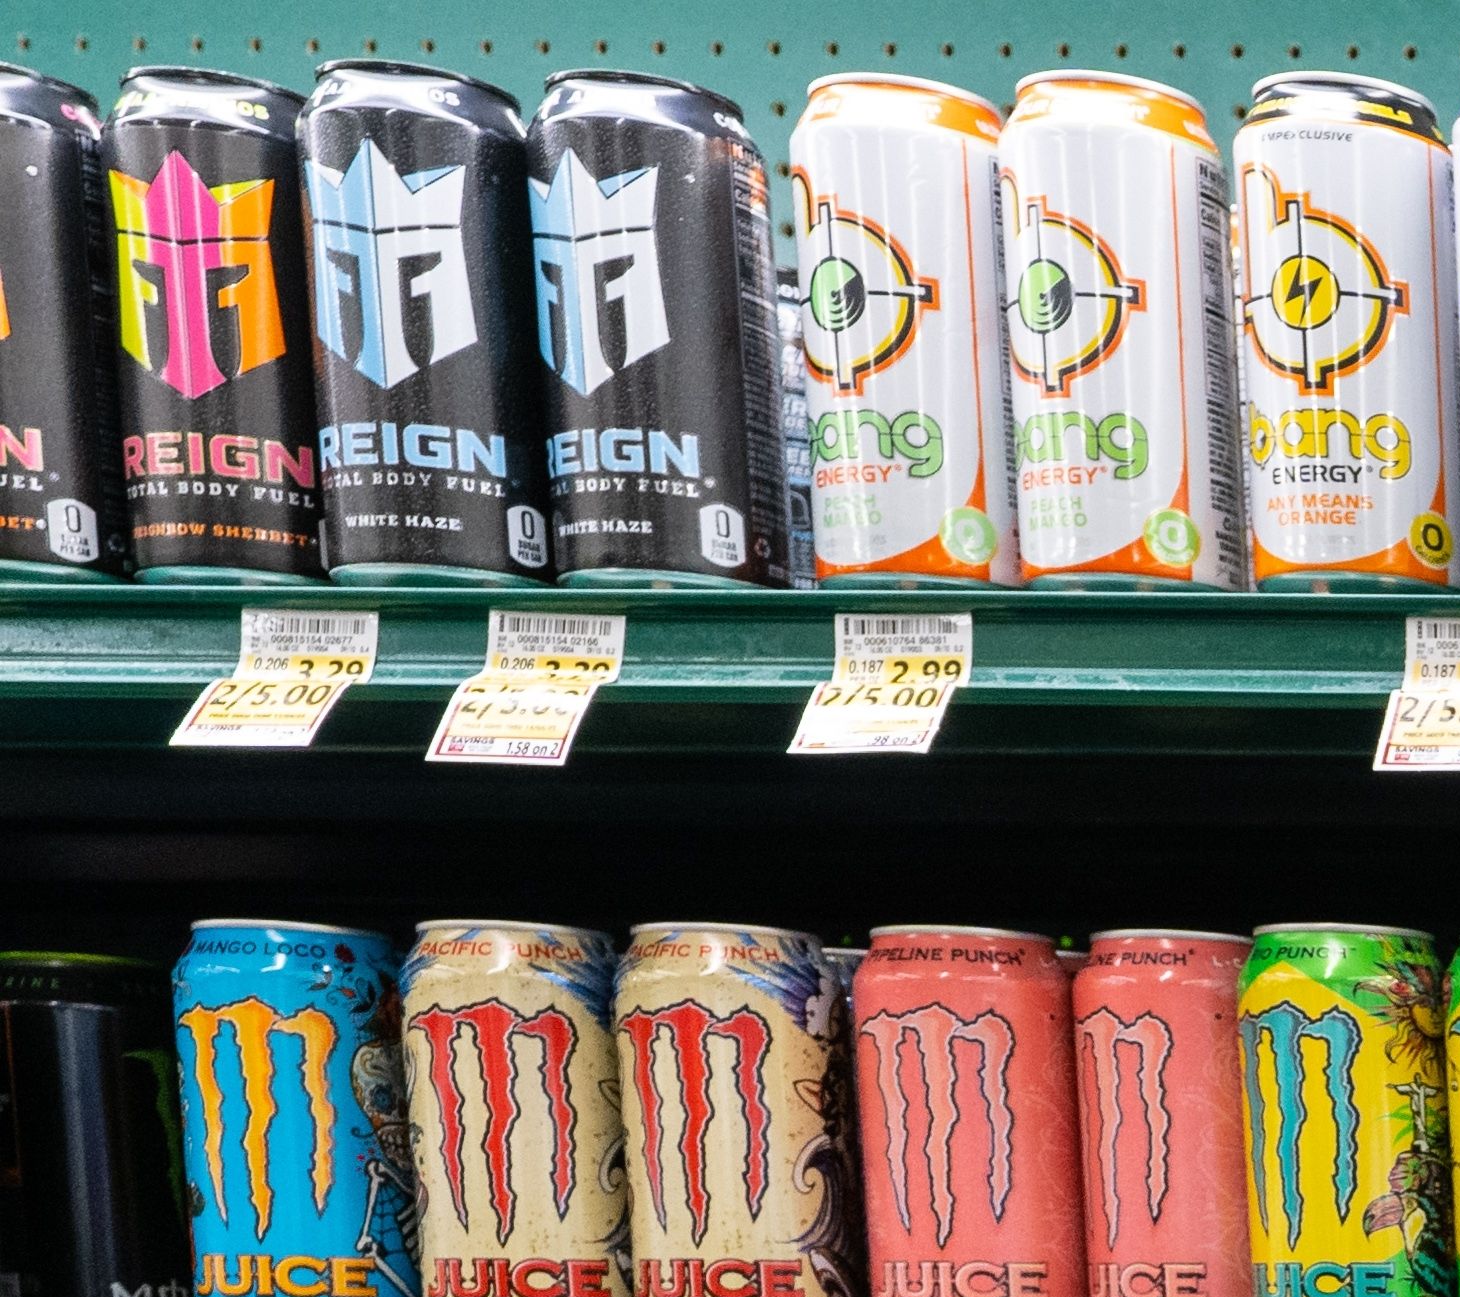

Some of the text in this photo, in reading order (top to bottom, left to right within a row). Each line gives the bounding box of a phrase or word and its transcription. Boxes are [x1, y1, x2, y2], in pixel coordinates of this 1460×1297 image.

[123, 431, 315, 483] REIGN
[345, 513, 462, 532] WHITE HAZE
